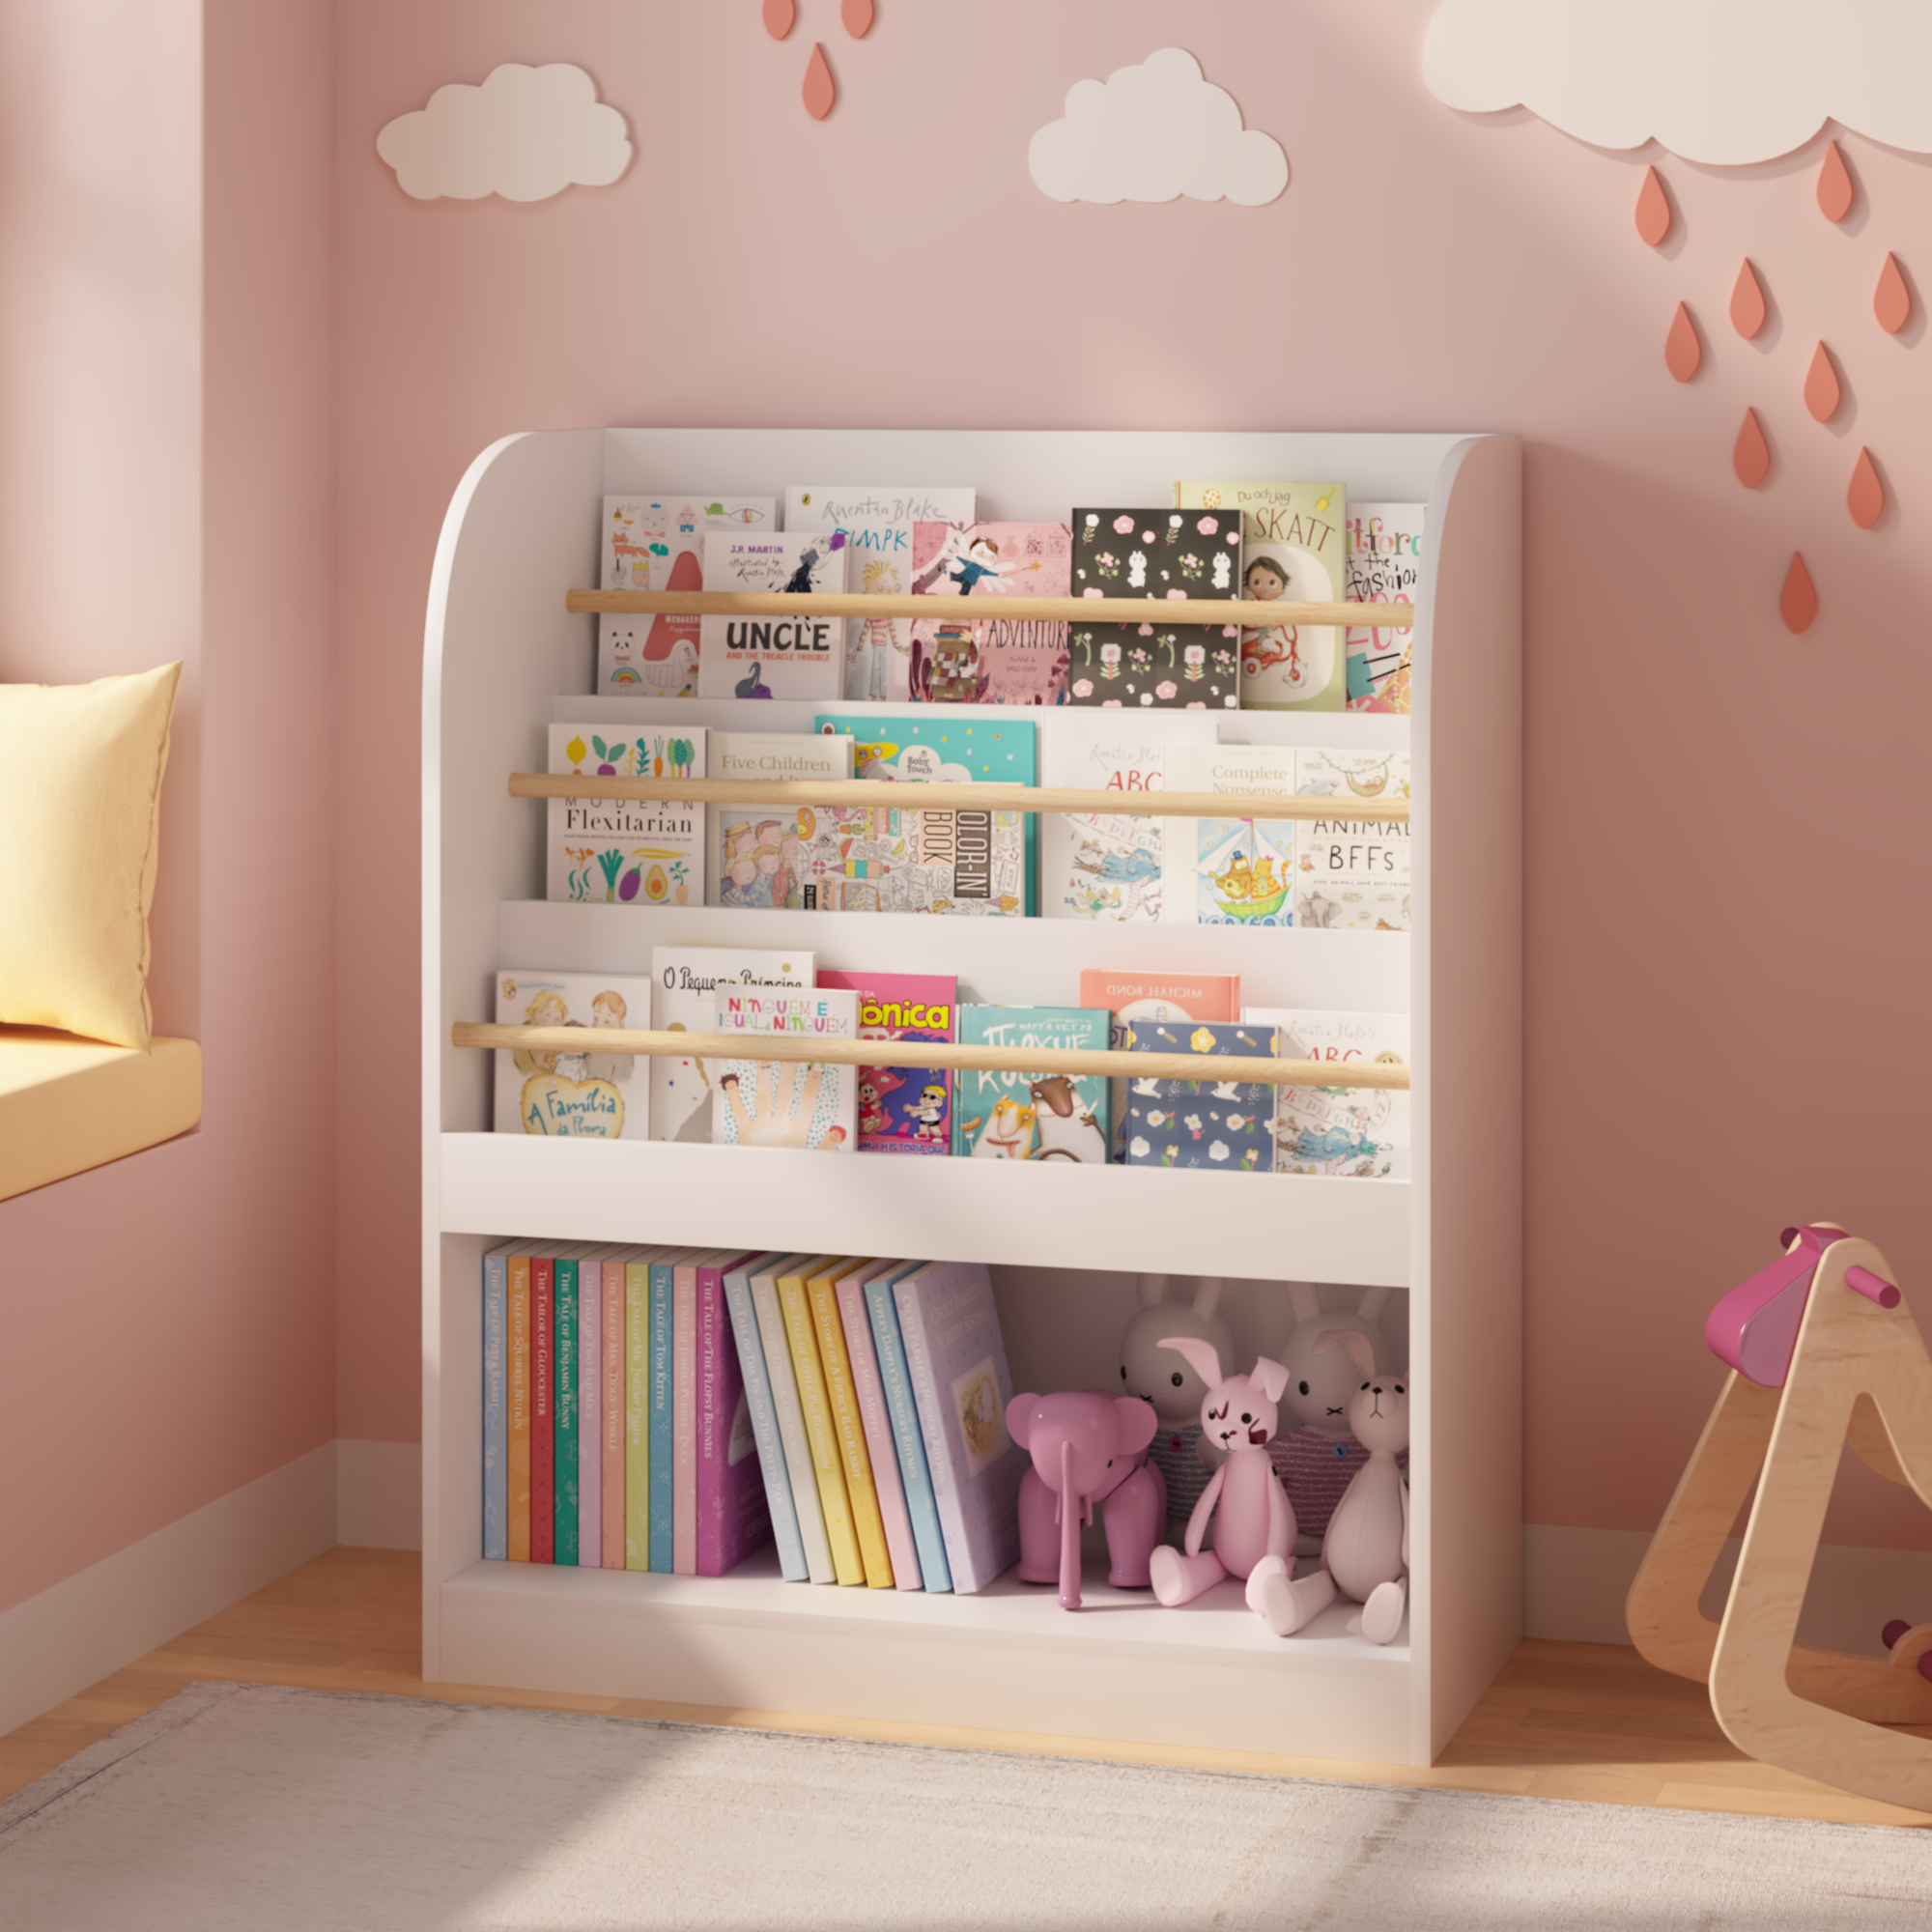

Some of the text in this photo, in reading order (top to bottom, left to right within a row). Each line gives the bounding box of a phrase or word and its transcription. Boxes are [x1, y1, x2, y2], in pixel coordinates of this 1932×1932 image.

[886, 497, 947, 525] Blake
[1237, 489, 1291, 506] Du och jag
[1254, 507, 1336, 552] SKATT
[729, 545, 783, 554] J.P. MARTIN
[1364, 554, 1390, 571] the
[1024, 580, 1036, 592] The
[726, 622, 830, 652] UNCLE
[762, 652, 794, 661] TREACLE
[797, 653, 831, 662] TROUBLE
[722, 754, 832, 771] Five Children
[907, 756, 930, 769] Baby
[907, 765, 933, 775] Touch
[1212, 765, 1289, 782] Complete
[1106, 770, 1162, 792] ABC
[564, 797, 695, 810] MODERN
[566, 809, 693, 834] Flexitarian
[923, 811, 953, 864] BOOK
[1330, 844, 1394, 870] BFFs
[665, 966, 675, 989] O
[719, 1013, 764, 1030] IGUAL
[860, 998, 951, 1030] ônica
[1019, 1022, 1093, 1033] МАРТА КЕТРО
[527, 1086, 616, 1136] A Família
[556, 1115, 607, 1137] da Flora
[927, 1145, 949, 1154] QUE
[513, 1268, 524, 1431] THE TALE OF SQUIRREL NUTKIN
[537, 1269, 548, 1416] THE TAILOR OF GLOUCESTER
[560, 1271, 571, 1430] THE TALE OF BENJAMIN BUNNY
[585, 1272, 595, 1419] THE TALE OF TWO BAD MICE
[657, 1276, 667, 1410] THE TALE OF TOM KITTEN
[609, 1274, 618, 1452] THE TALE OF MRS. TIGGY-WINKLE
[631, 1276, 641, 1445] THE TALE OF MR. JEREMY FISHER
[678, 1278, 690, 1465] THE TALE OF JEMIMA PUDDLE-DUCK
[704, 1280, 714, 1459] THE TALE OF THE FLOPSY BUNNIES
[845, 1293, 882, 1438] THE STORY OF MISS MOPPET
[733, 1286, 783, 1504] THE TALE OF THE PIE AND THE PATTY-PAN
[787, 1291, 832, 1470] THE TALE OF LITTLE PIG ROBINSON
[816, 1292, 863, 1479] THE STORY OF A FIERCE BAD RABBIT
[874, 1294, 920, 1478] APPLEY DAPPLY'S NURSERY RHYMES
[903, 1295, 948, 1482] CECILY PARSLEY'S NURSERY RHYMES
